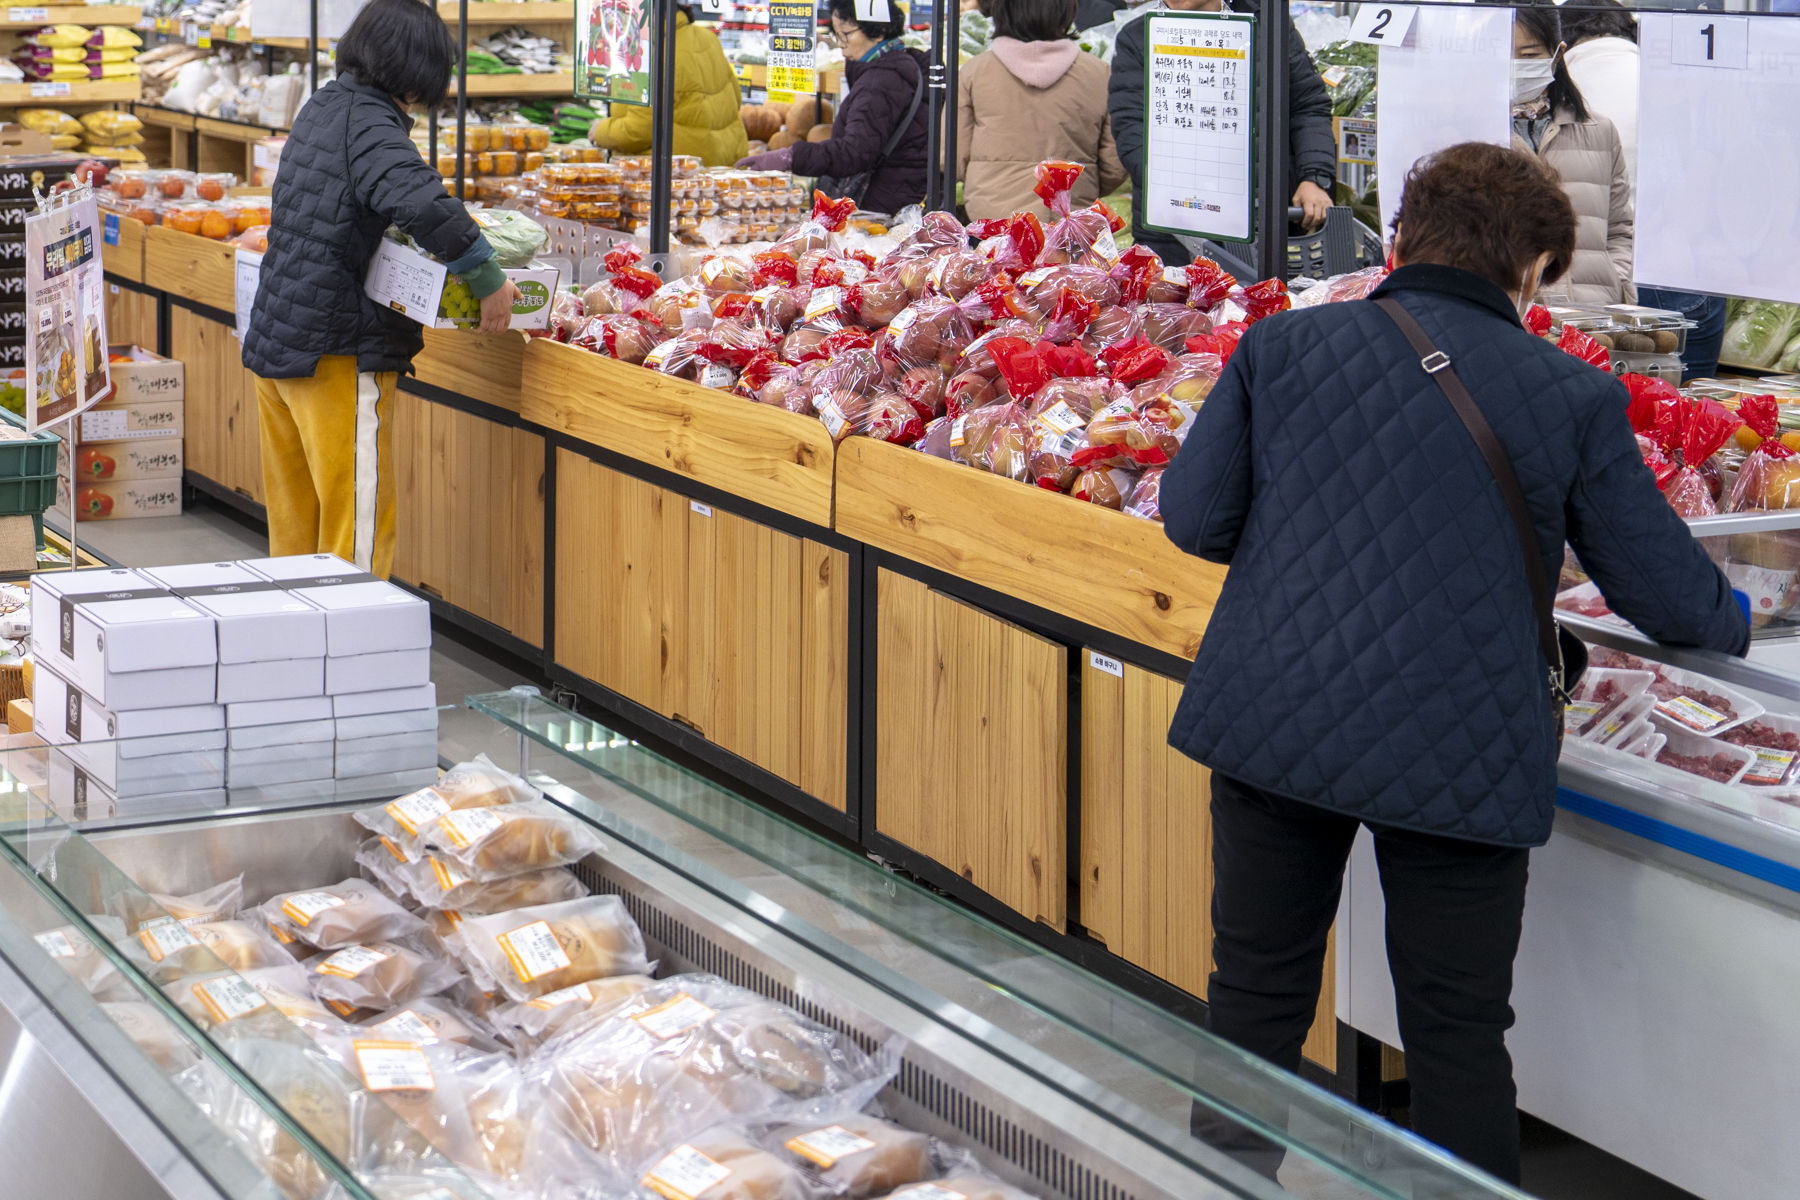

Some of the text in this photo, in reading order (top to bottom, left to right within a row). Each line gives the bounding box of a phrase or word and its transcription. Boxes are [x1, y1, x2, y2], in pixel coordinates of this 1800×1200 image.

[770, 6, 812, 17] CCTV녹화중
[1368, 8, 1393, 39] 2
[1700, 23, 1715, 60] 1
